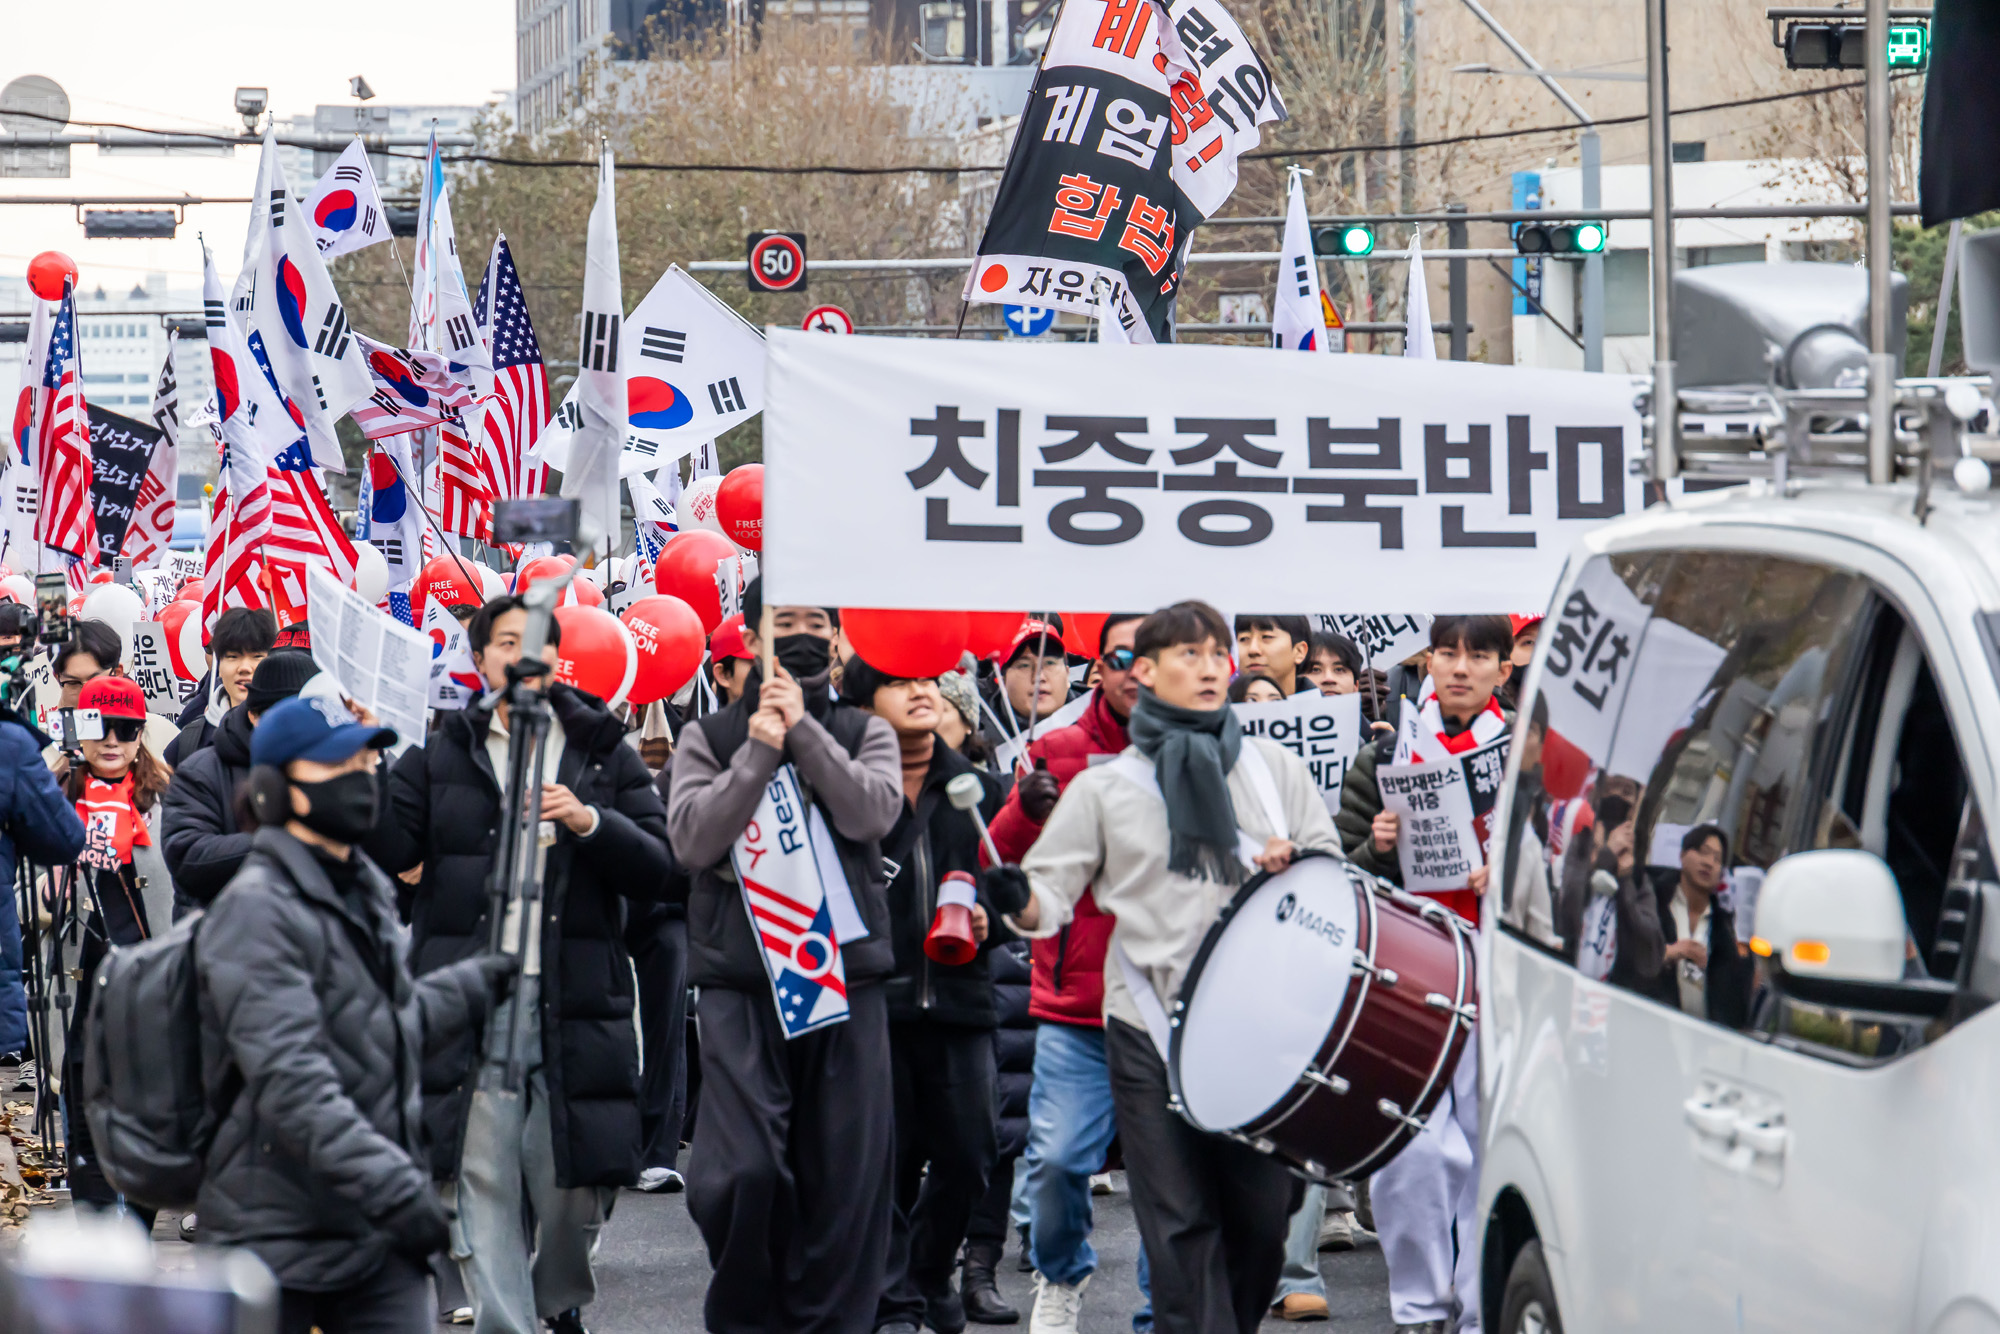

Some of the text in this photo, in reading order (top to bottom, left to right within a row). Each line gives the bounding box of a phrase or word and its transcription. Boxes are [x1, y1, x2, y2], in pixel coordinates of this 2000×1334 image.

[1042, 86, 1170, 171] 계엄
[762, 249, 793, 276] 50
[733, 529, 764, 539] YOO
[734, 519, 764, 529] FREE
[429, 579, 453, 591] FREE
[431, 589, 460, 601] OON
[628, 616, 661, 640] FREE
[629, 630, 659, 656] OON
[1381, 767, 1461, 795] 헌법재판소
[1407, 791, 1440, 812] 위증
[1410, 829, 1459, 847] 국회의원
[1412, 859, 1472, 878] 지시받았다
[1294, 905, 1347, 947] MARS
